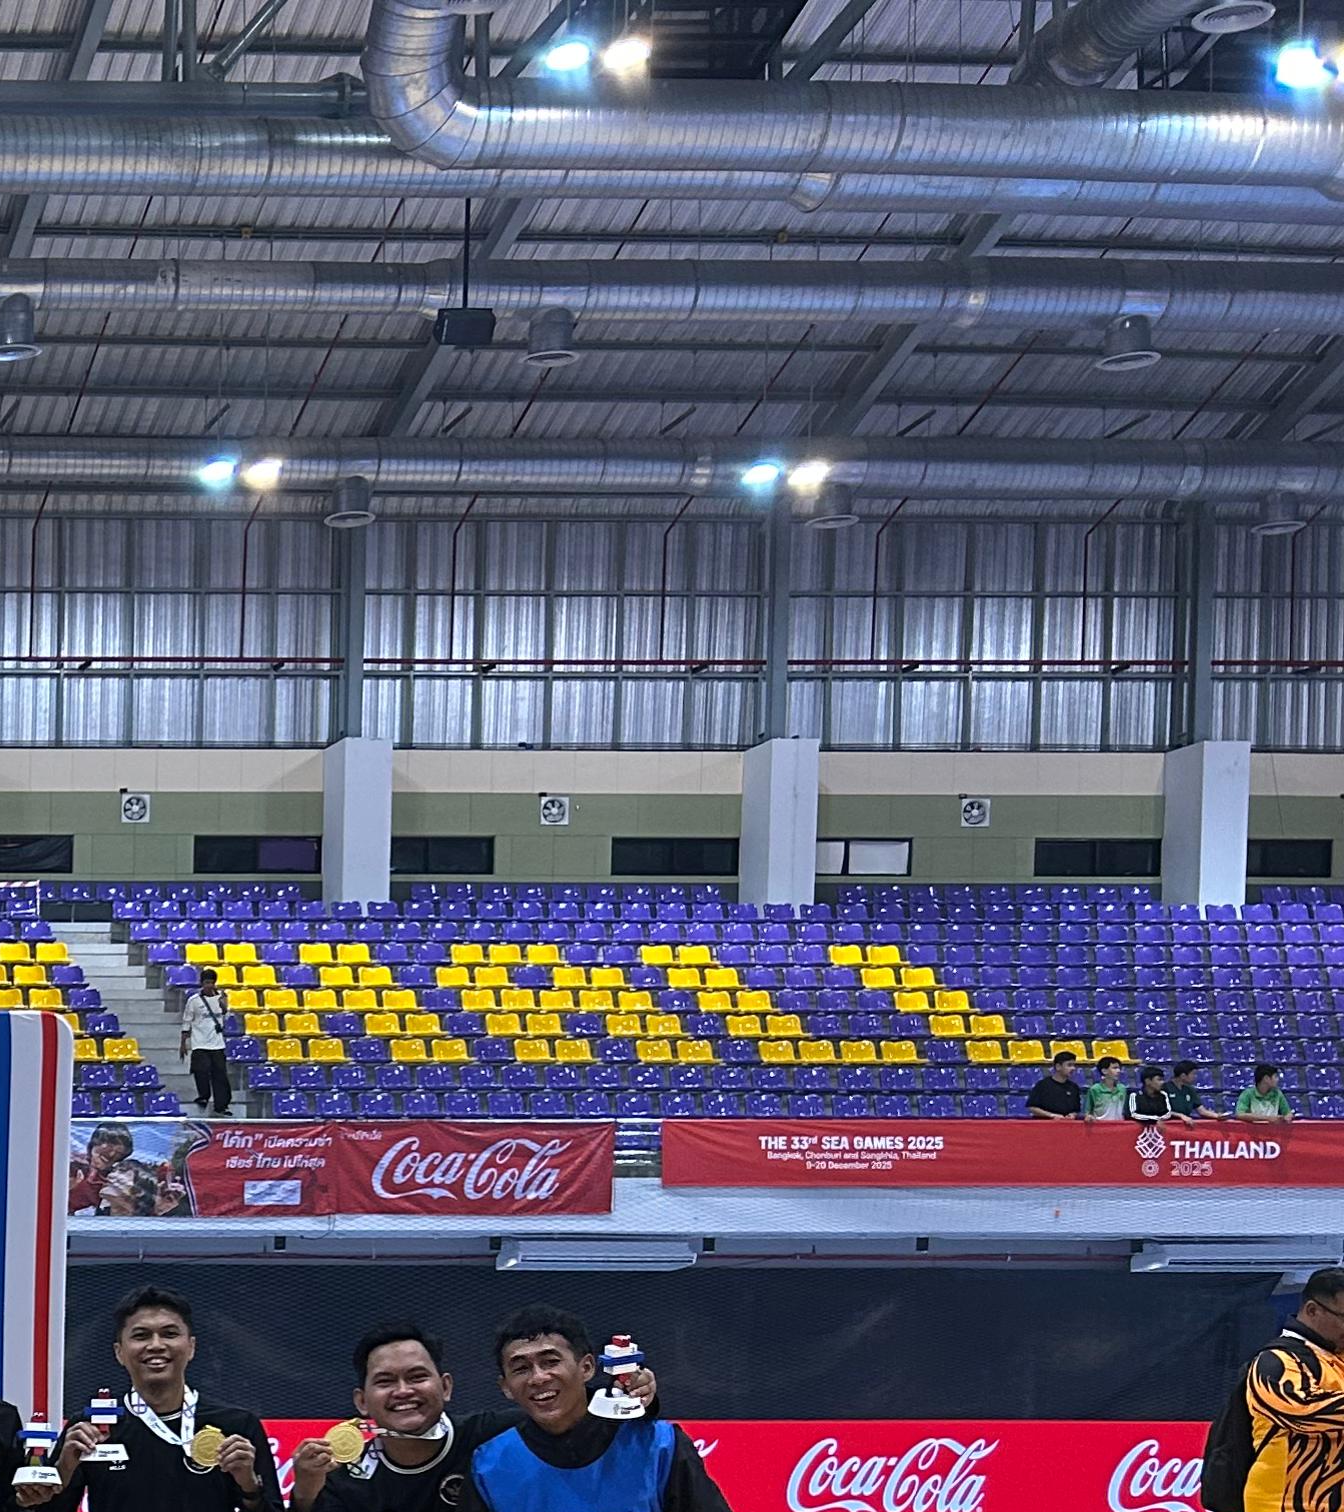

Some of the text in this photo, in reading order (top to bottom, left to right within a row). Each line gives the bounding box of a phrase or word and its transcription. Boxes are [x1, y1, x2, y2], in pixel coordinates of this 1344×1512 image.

[759, 1136, 787, 1150] THE
[821, 1137, 849, 1150] SEA
[853, 1137, 904, 1150] GAMES
[907, 1136, 944, 1150] 2025
[1170, 1141, 1281, 1159] THAILAND
[371, 1136, 567, 1200] Coca-Cola
[1170, 1161, 1212, 1176] 2025
